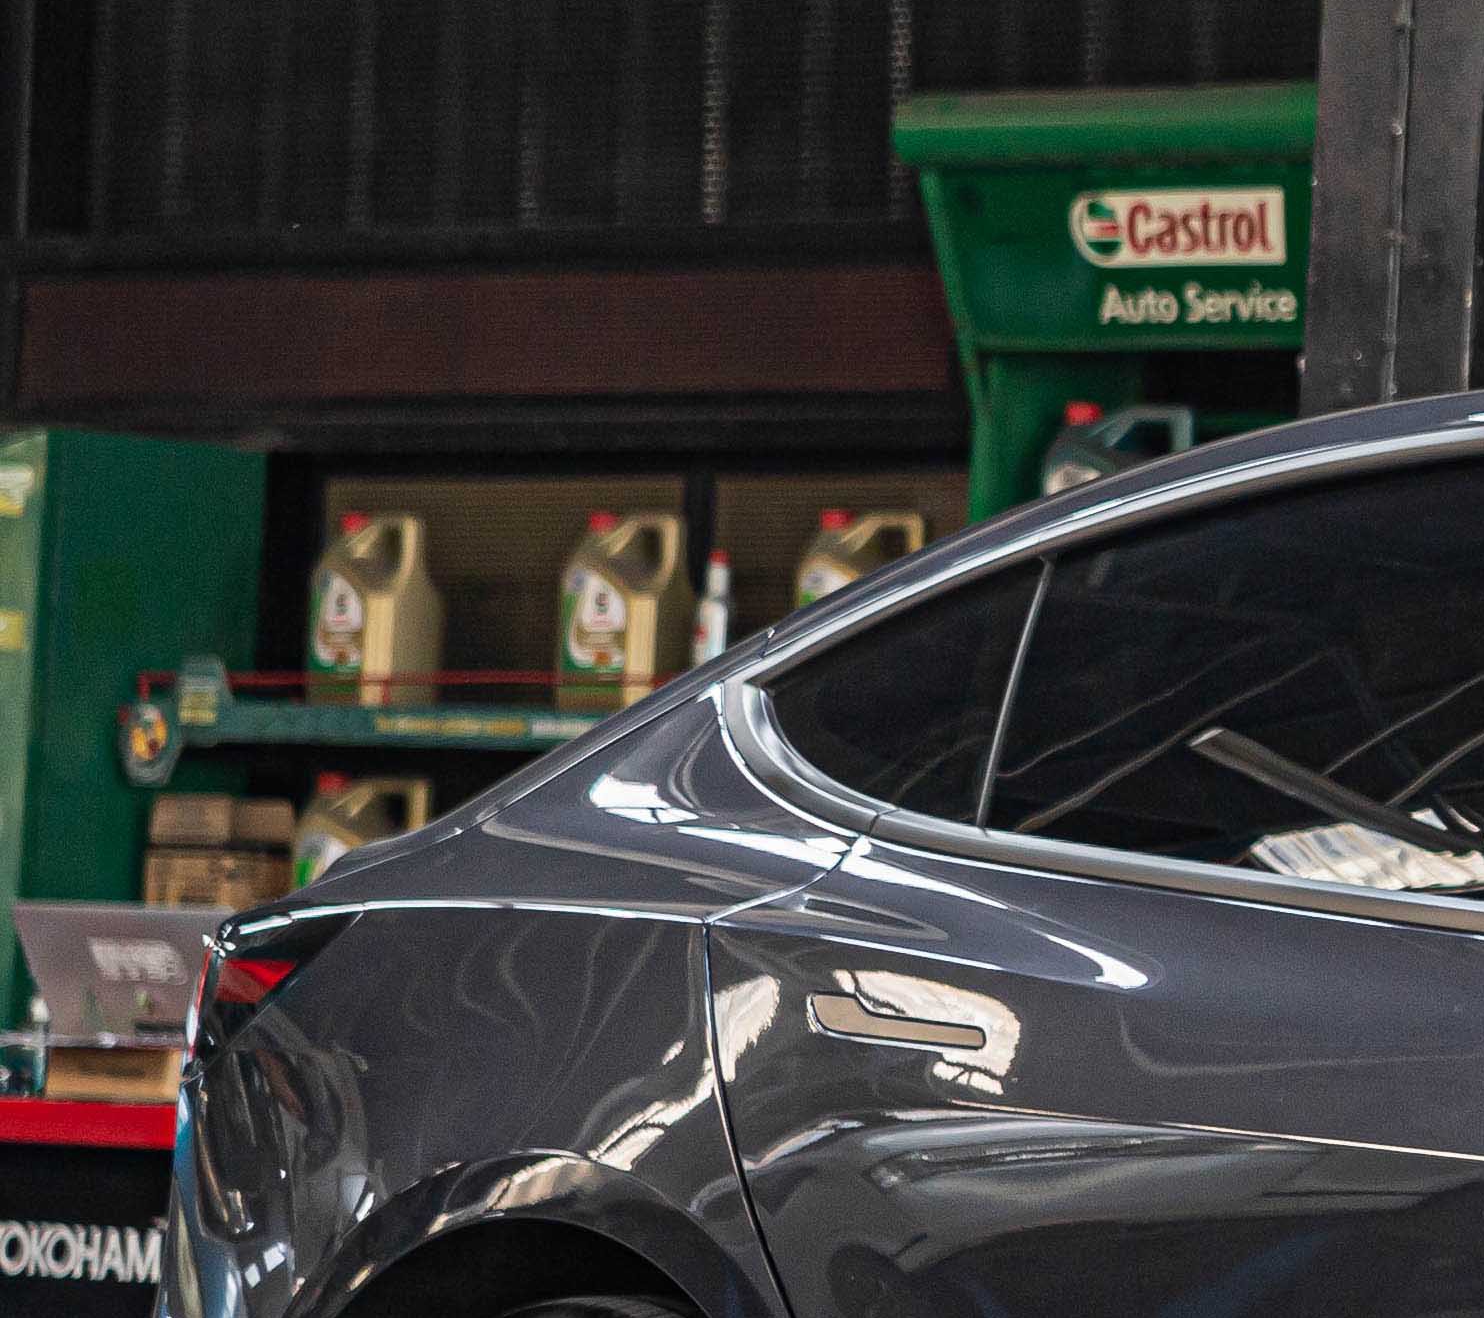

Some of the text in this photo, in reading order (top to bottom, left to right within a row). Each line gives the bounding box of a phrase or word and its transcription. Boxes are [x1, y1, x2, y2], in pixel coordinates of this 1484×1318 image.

[1125, 200, 1272, 261] Castrol
[1100, 282, 1296, 324] Auto Service
[0, 1219, 163, 1284] OKOHAM
